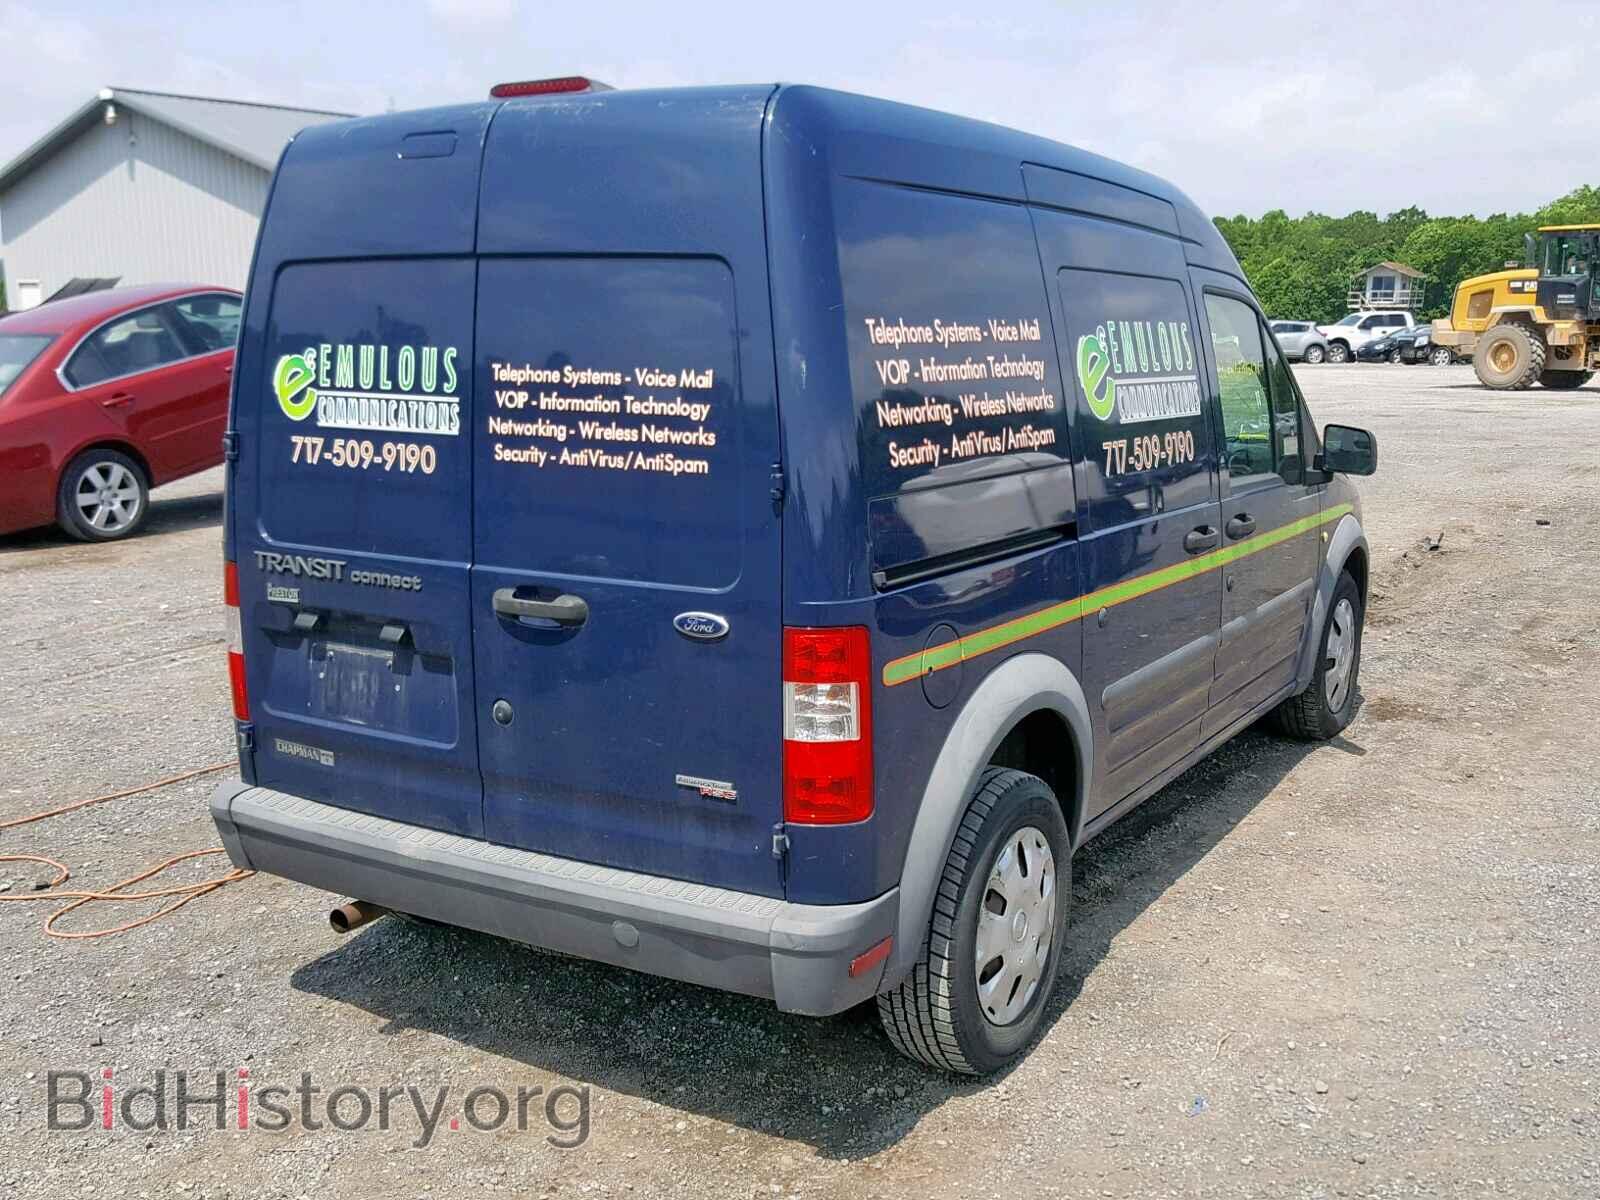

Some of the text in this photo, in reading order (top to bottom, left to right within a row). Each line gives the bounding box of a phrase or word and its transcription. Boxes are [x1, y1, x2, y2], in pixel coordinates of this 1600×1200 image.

[865, 317, 933, 349] Telephone
[934, 319, 982, 348] Systems
[988, 319, 1018, 342] Voice
[1019, 318, 1040, 341] Mail
[1107, 320, 1193, 374] EMULOUS
[320, 344, 457, 393] EMULOUS
[492, 364, 560, 386] Telephone
[564, 366, 622, 388] Systems
[635, 368, 676, 387] Voice
[680, 369, 713, 388] Mail
[876, 359, 910, 385] VOIP
[920, 356, 987, 383] Information
[987, 353, 1044, 380] Technology
[318, 396, 460, 433] COMMUNICATIONS
[495, 390, 528, 408] VOIP
[540, 392, 620, 413] Information
[624, 396, 710, 421] Technology
[876, 397, 952, 428] Networking
[959, 392, 1006, 418] Wireless
[1006, 388, 1054, 413] Networks
[489, 417, 566, 442] Networking
[578, 420, 638, 442] Wireless
[642, 424, 716, 446] Networks
[290, 436, 436, 474] 717-509-9190
[494, 444, 546, 468] Security
[888, 438, 940, 468] Security
[1103, 430, 1194, 478] 717-509-9190
[254, 550, 422, 590] TRANSIT connect
[684, 618, 714, 632] Ford
